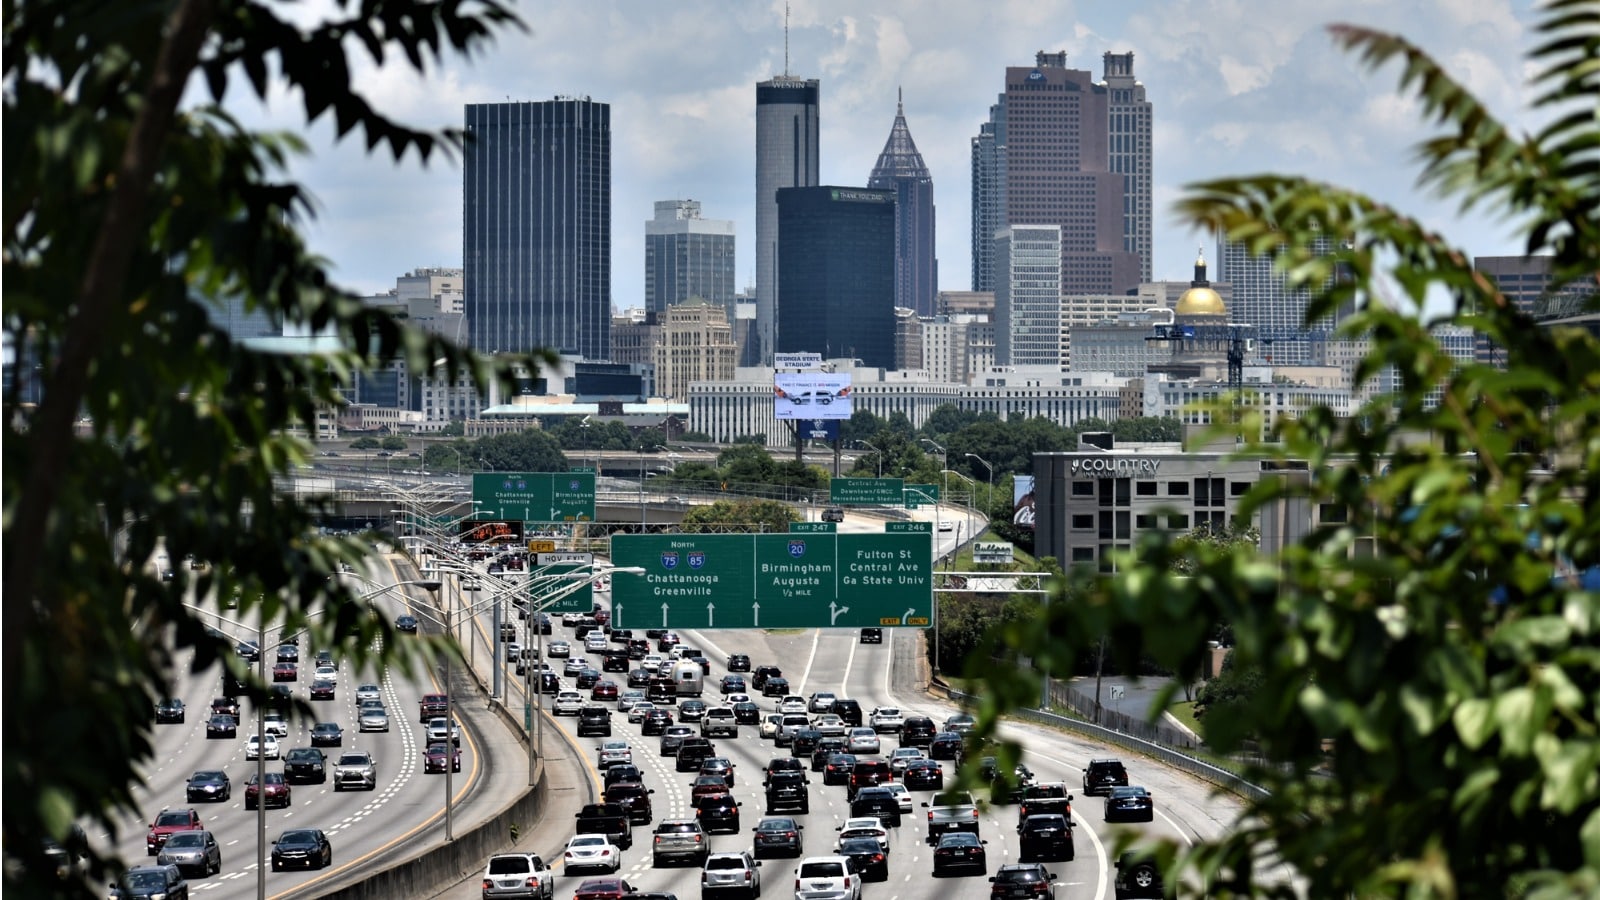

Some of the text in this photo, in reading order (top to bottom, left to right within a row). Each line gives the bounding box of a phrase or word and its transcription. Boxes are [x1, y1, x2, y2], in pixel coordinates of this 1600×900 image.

[1082, 458, 1160, 470] COUNTRY
[791, 545, 803, 554] 20
[858, 550, 911, 558] Fulton St
[664, 557, 702, 565] 75 85
[762, 564, 831, 574] Birmingham
[850, 563, 891, 571] Central
[647, 574, 718, 584] Chattanooga
[773, 577, 820, 587] Augusta
[843, 576, 924, 585] Ga State Univ
[654, 587, 712, 596] Greenville
